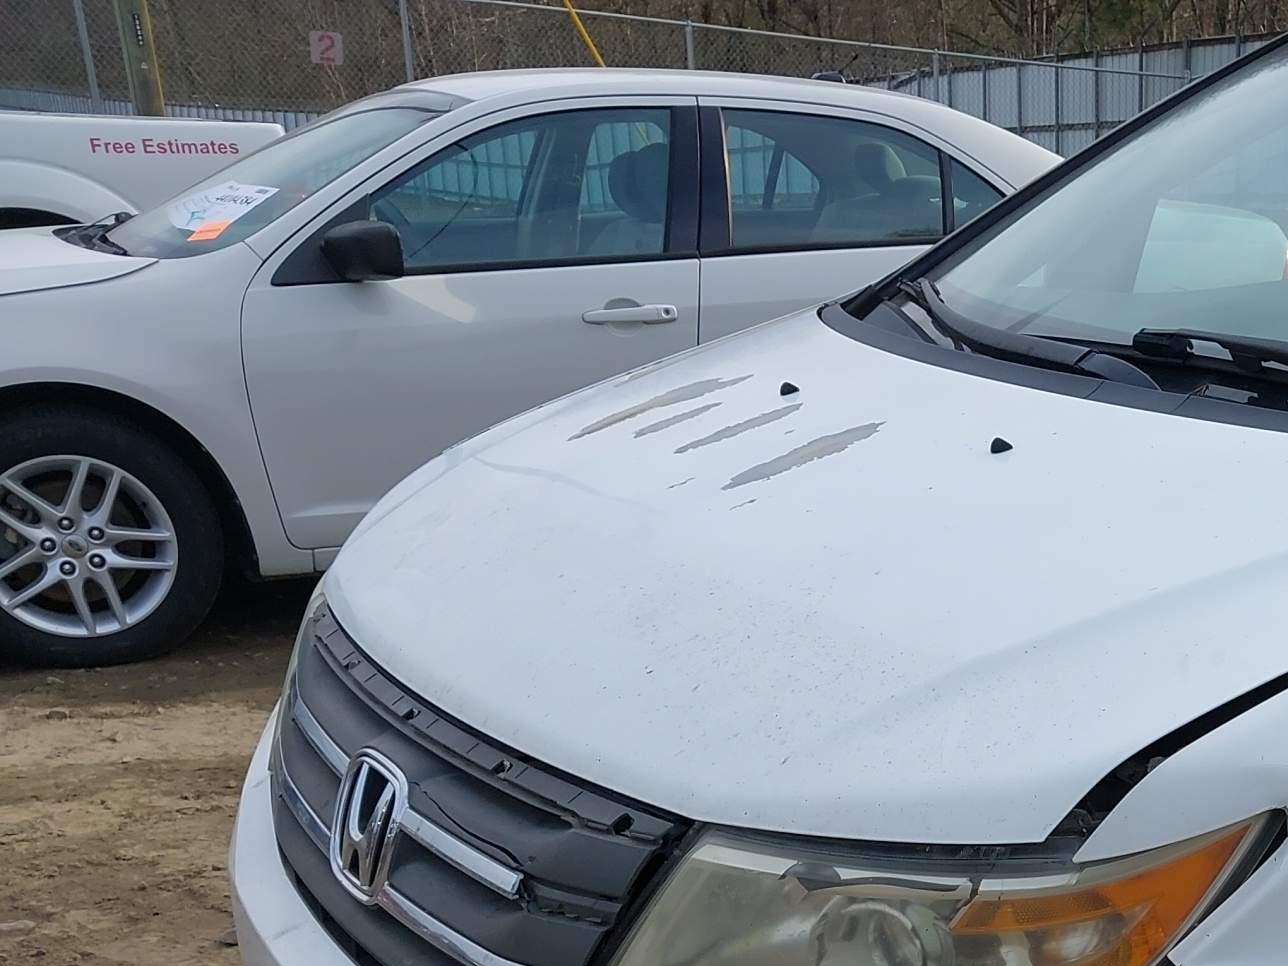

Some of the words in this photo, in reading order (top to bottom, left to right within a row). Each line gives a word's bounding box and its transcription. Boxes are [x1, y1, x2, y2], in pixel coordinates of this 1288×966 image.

[318, 34, 336, 62] 2
[89, 138, 136, 154] Free
[142, 138, 240, 154] Estimates
